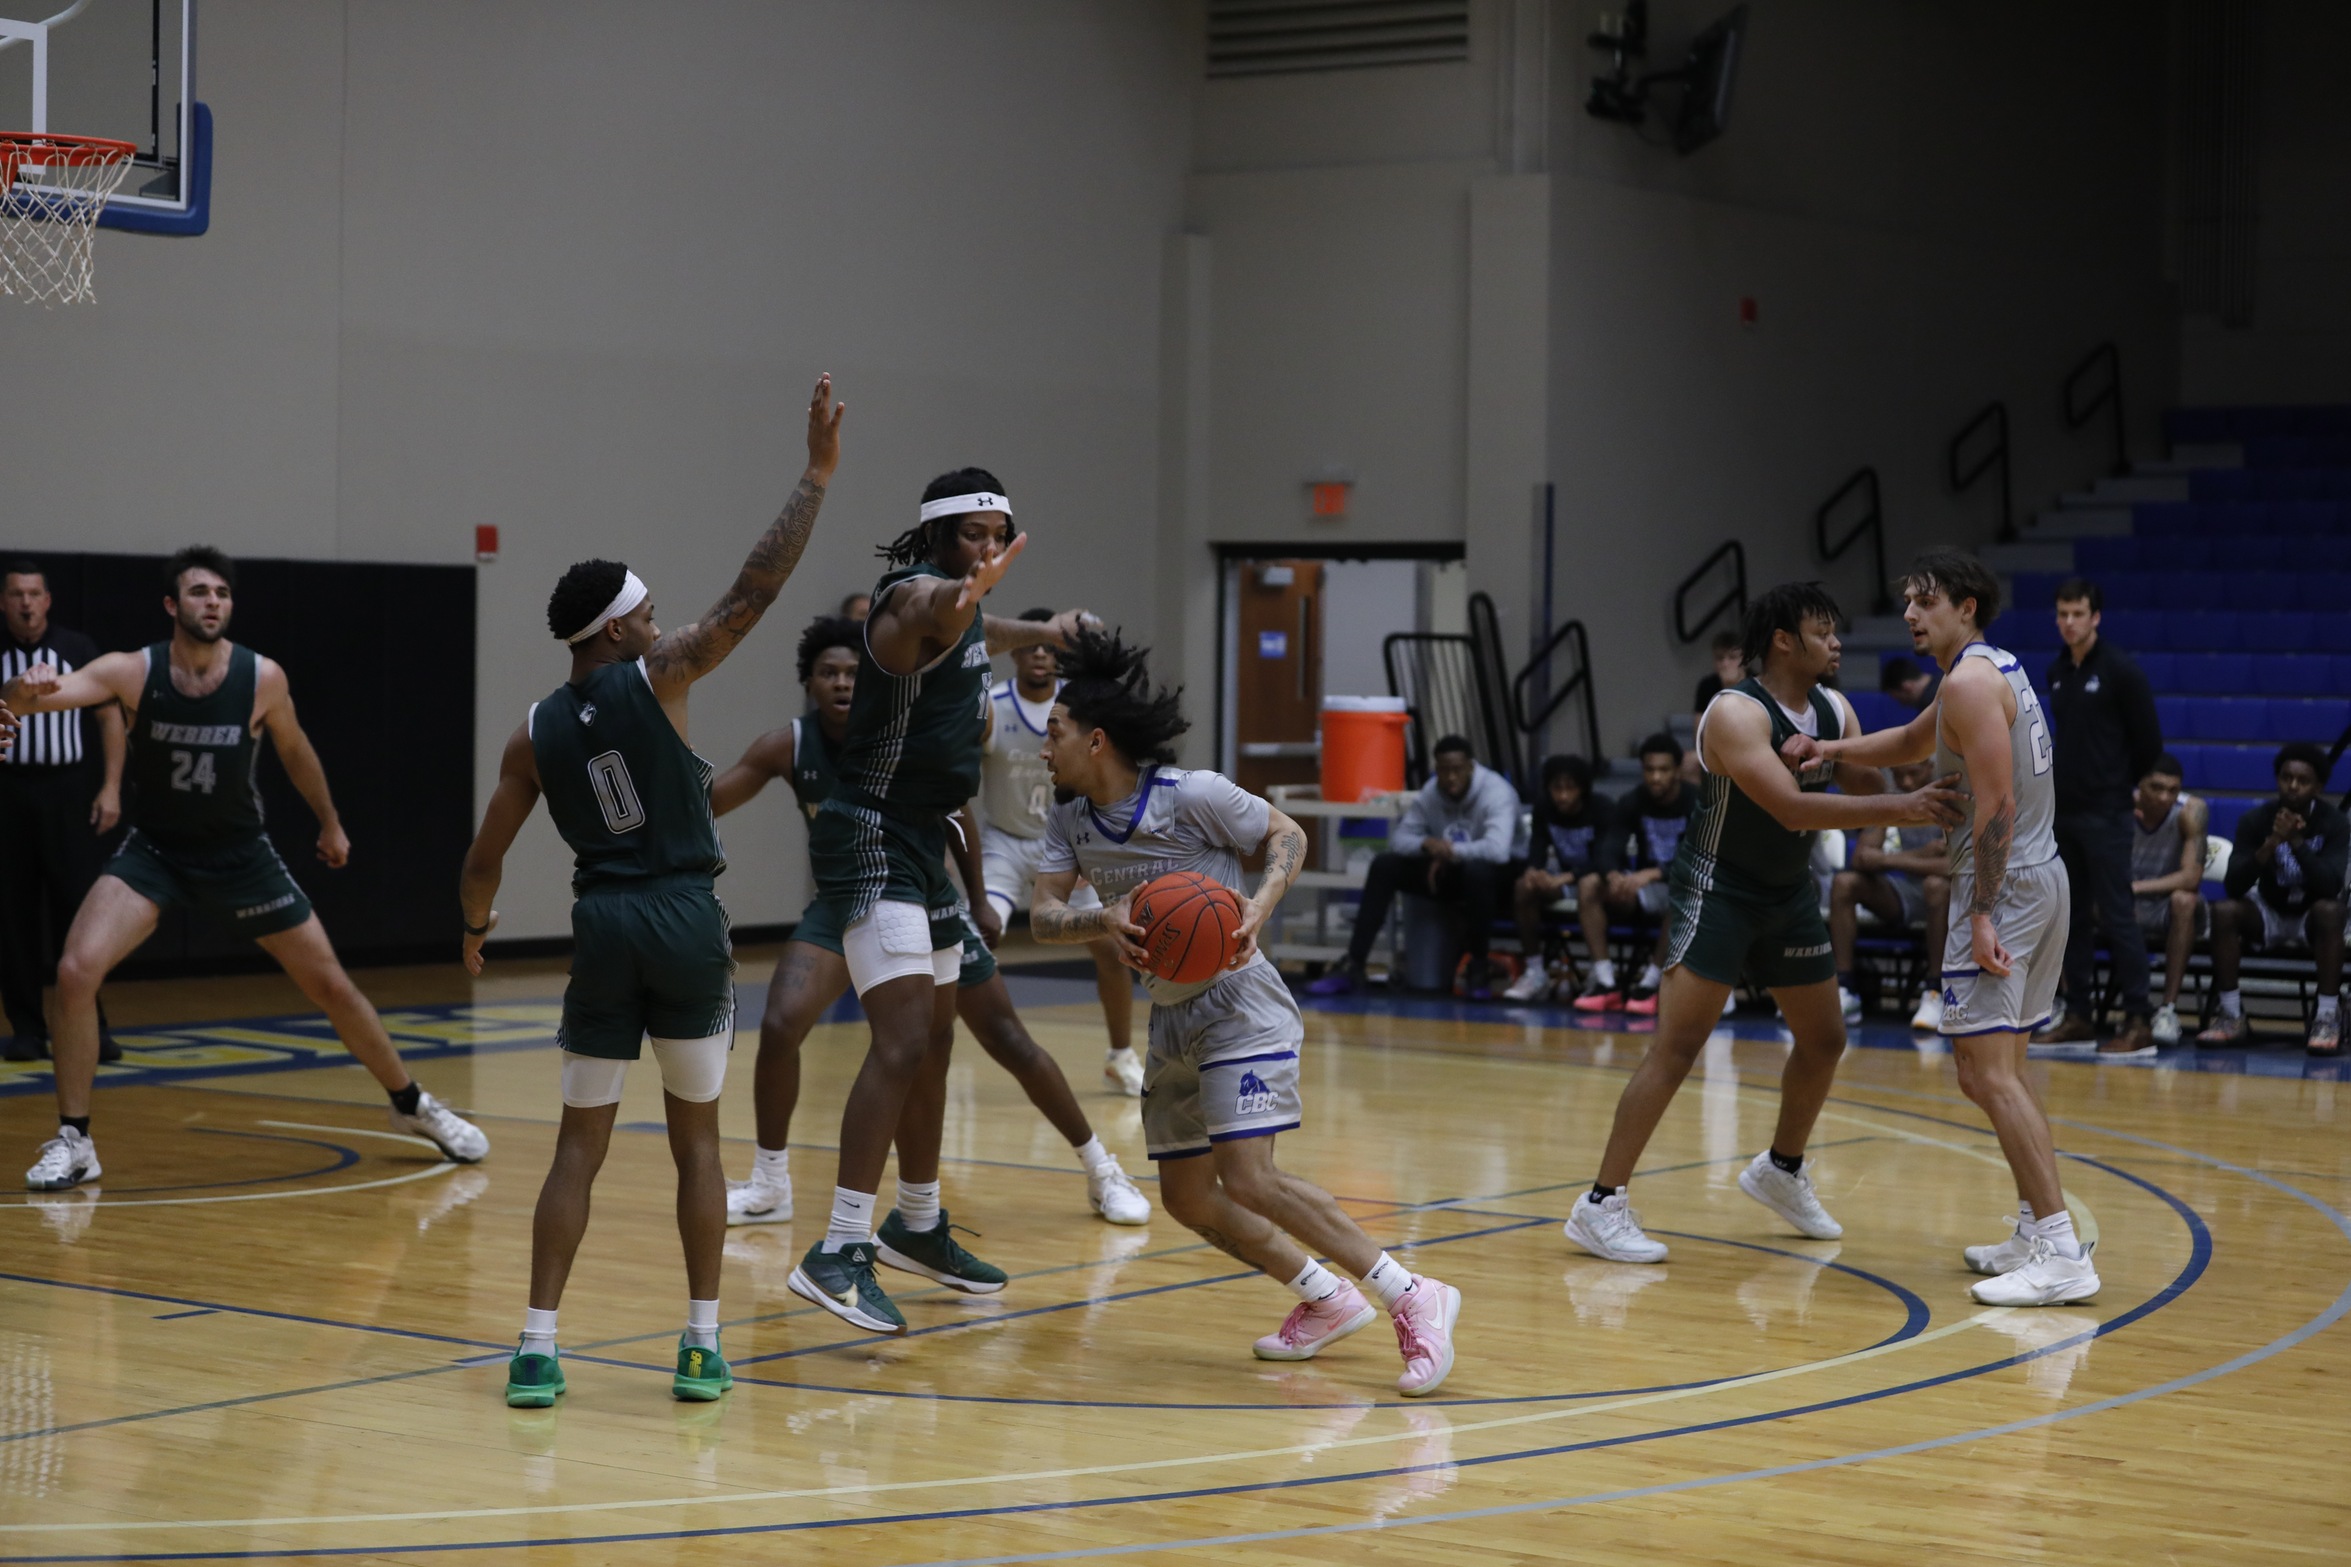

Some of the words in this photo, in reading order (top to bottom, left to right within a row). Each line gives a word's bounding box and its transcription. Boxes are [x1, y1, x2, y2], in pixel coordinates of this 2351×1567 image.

[2021, 686, 2053, 776] 2
[171, 750, 217, 795] 24
[587, 750, 645, 834] 0
[1089, 857, 1180, 887] CENTRAL
[1942, 1003, 1970, 1020] BC
[1234, 1091, 1280, 1116] CBC
